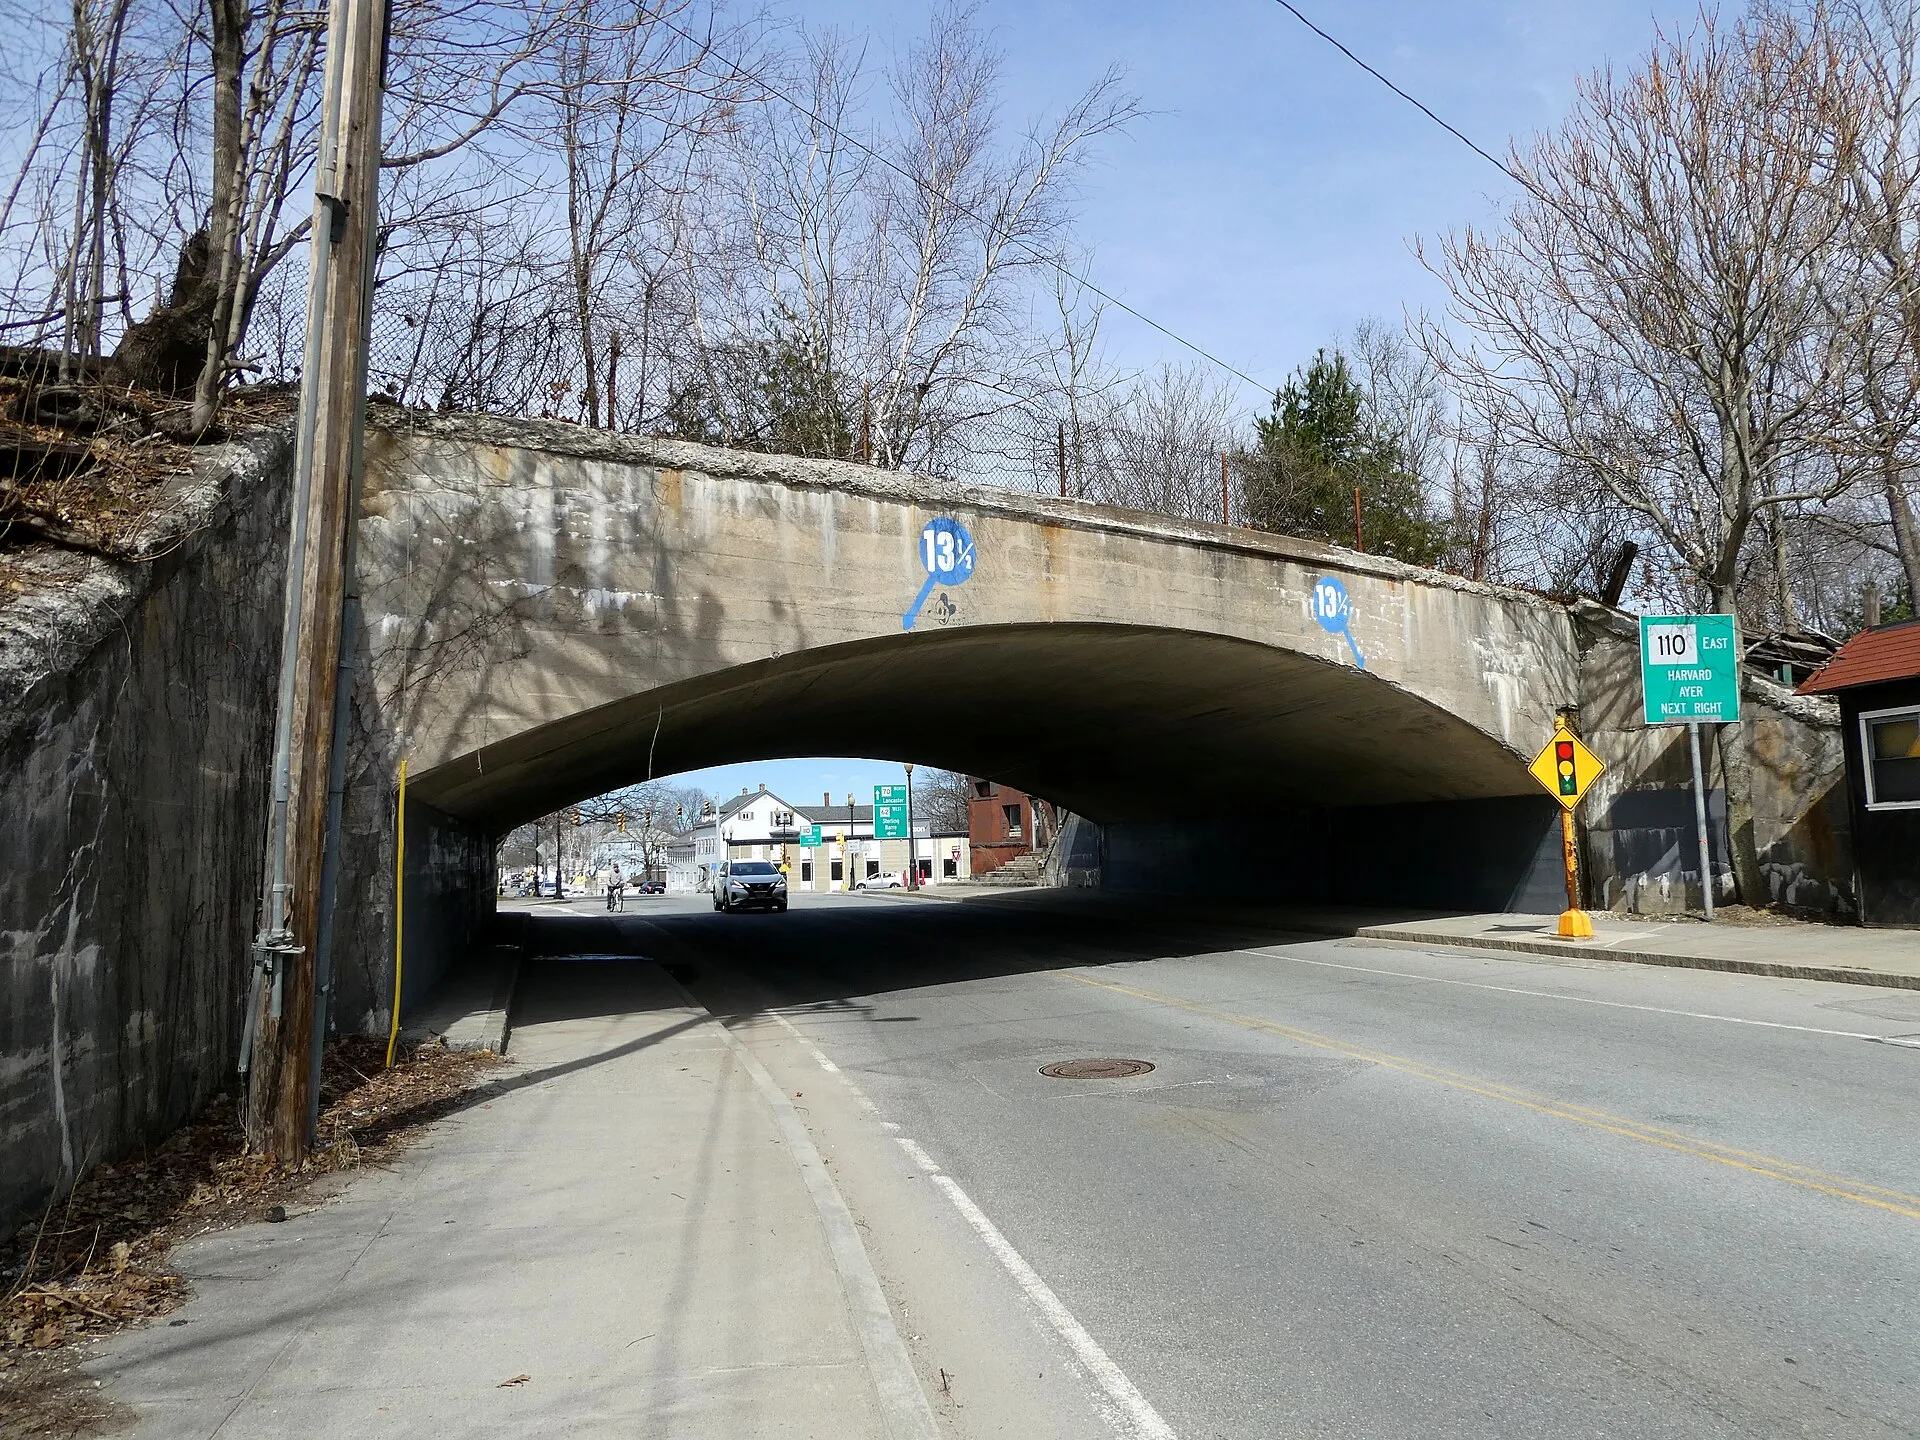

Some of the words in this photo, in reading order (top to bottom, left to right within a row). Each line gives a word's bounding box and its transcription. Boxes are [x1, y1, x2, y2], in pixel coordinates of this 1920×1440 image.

[1658, 634, 1686, 656] 110
[1702, 636, 1728, 649] EAST
[1667, 669, 1712, 681] HARVARD
[1679, 686, 1704, 697] AYER
[1660, 702, 1686, 714] NEXT
[1694, 702, 1723, 713] RIGHT
